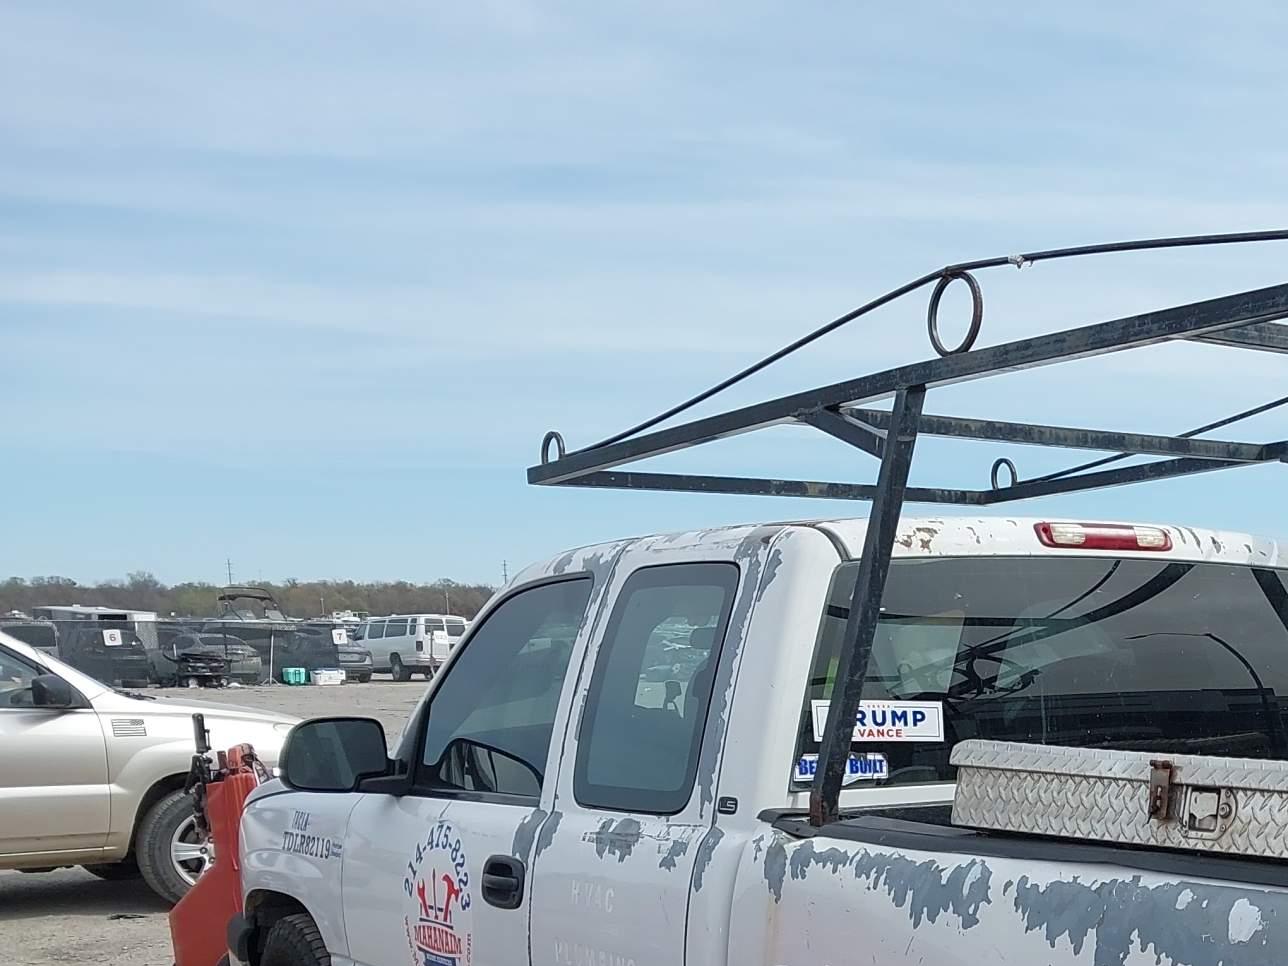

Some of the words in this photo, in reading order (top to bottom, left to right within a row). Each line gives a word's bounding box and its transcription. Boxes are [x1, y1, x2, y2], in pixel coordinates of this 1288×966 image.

[856, 710, 926, 727] RUMP
[857, 728, 904, 739] VANCE
[849, 758, 885, 775] BUILT
[282, 831, 331, 859] TDLR82119
[403, 823, 471, 911] 214-475-8223
[413, 924, 463, 955] MAHANAIM
